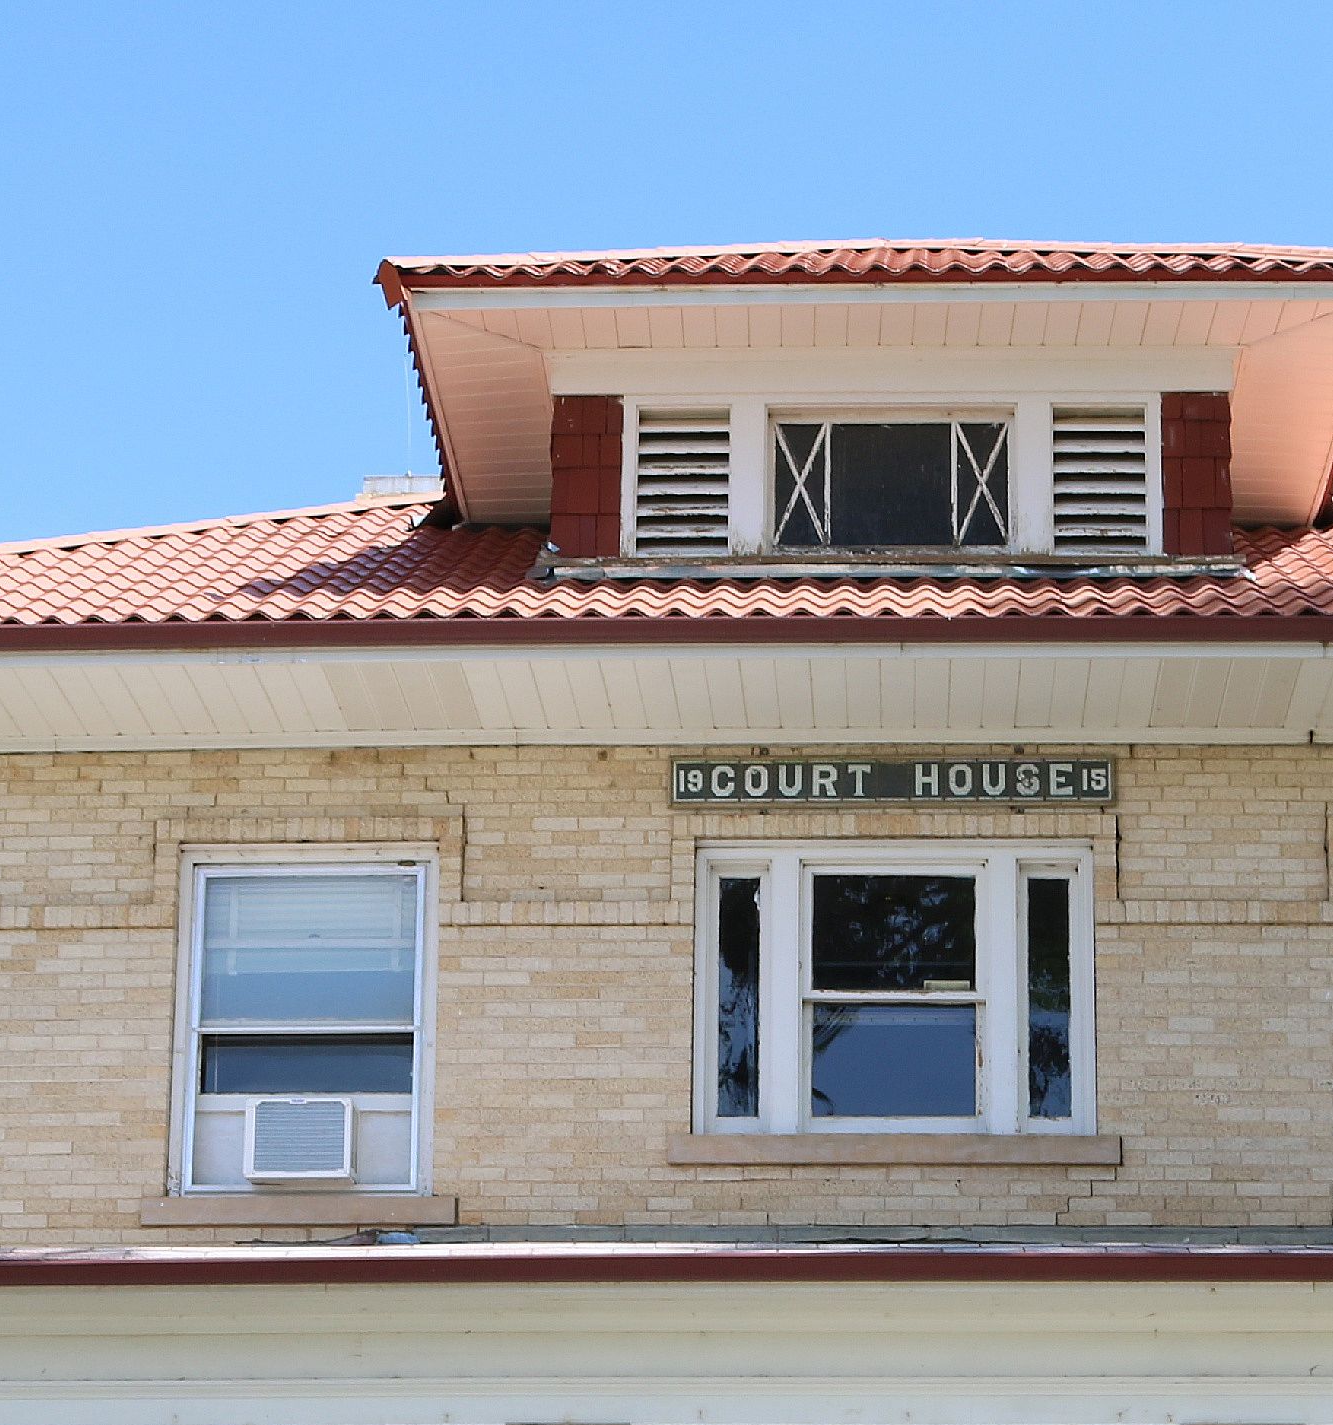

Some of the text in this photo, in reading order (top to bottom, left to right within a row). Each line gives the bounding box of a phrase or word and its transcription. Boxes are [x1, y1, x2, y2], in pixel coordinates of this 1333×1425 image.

[678, 763, 1107, 797] 19 COURT HOUSE 15
